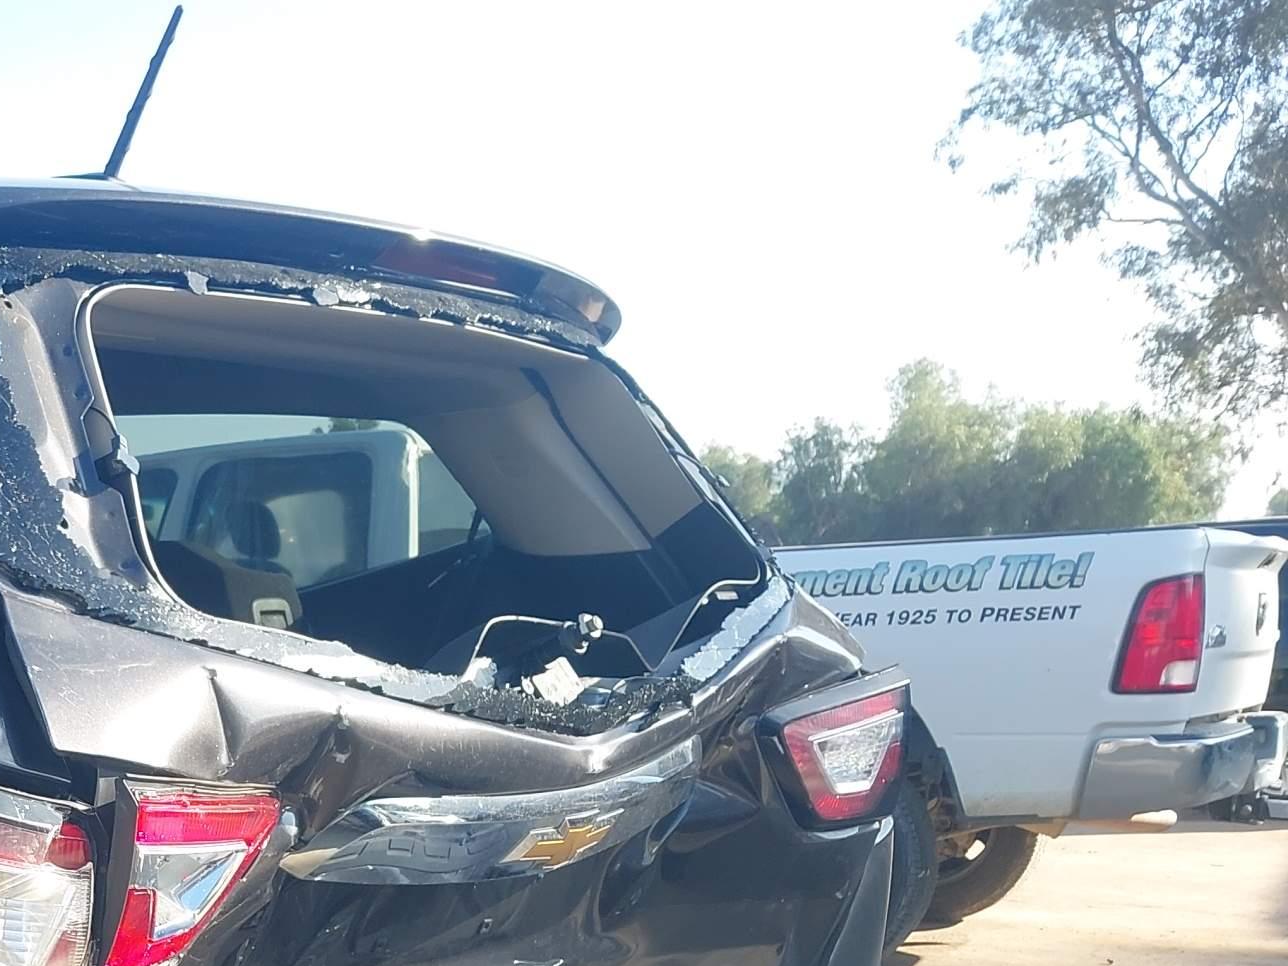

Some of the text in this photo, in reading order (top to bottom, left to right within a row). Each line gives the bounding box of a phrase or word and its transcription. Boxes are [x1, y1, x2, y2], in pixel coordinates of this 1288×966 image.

[892, 555, 995, 594] Roof
[998, 552, 1095, 590] Tile!
[887, 608, 937, 625] 1925
[946, 609, 972, 623] TO
[980, 605, 1081, 623] PRESENT
